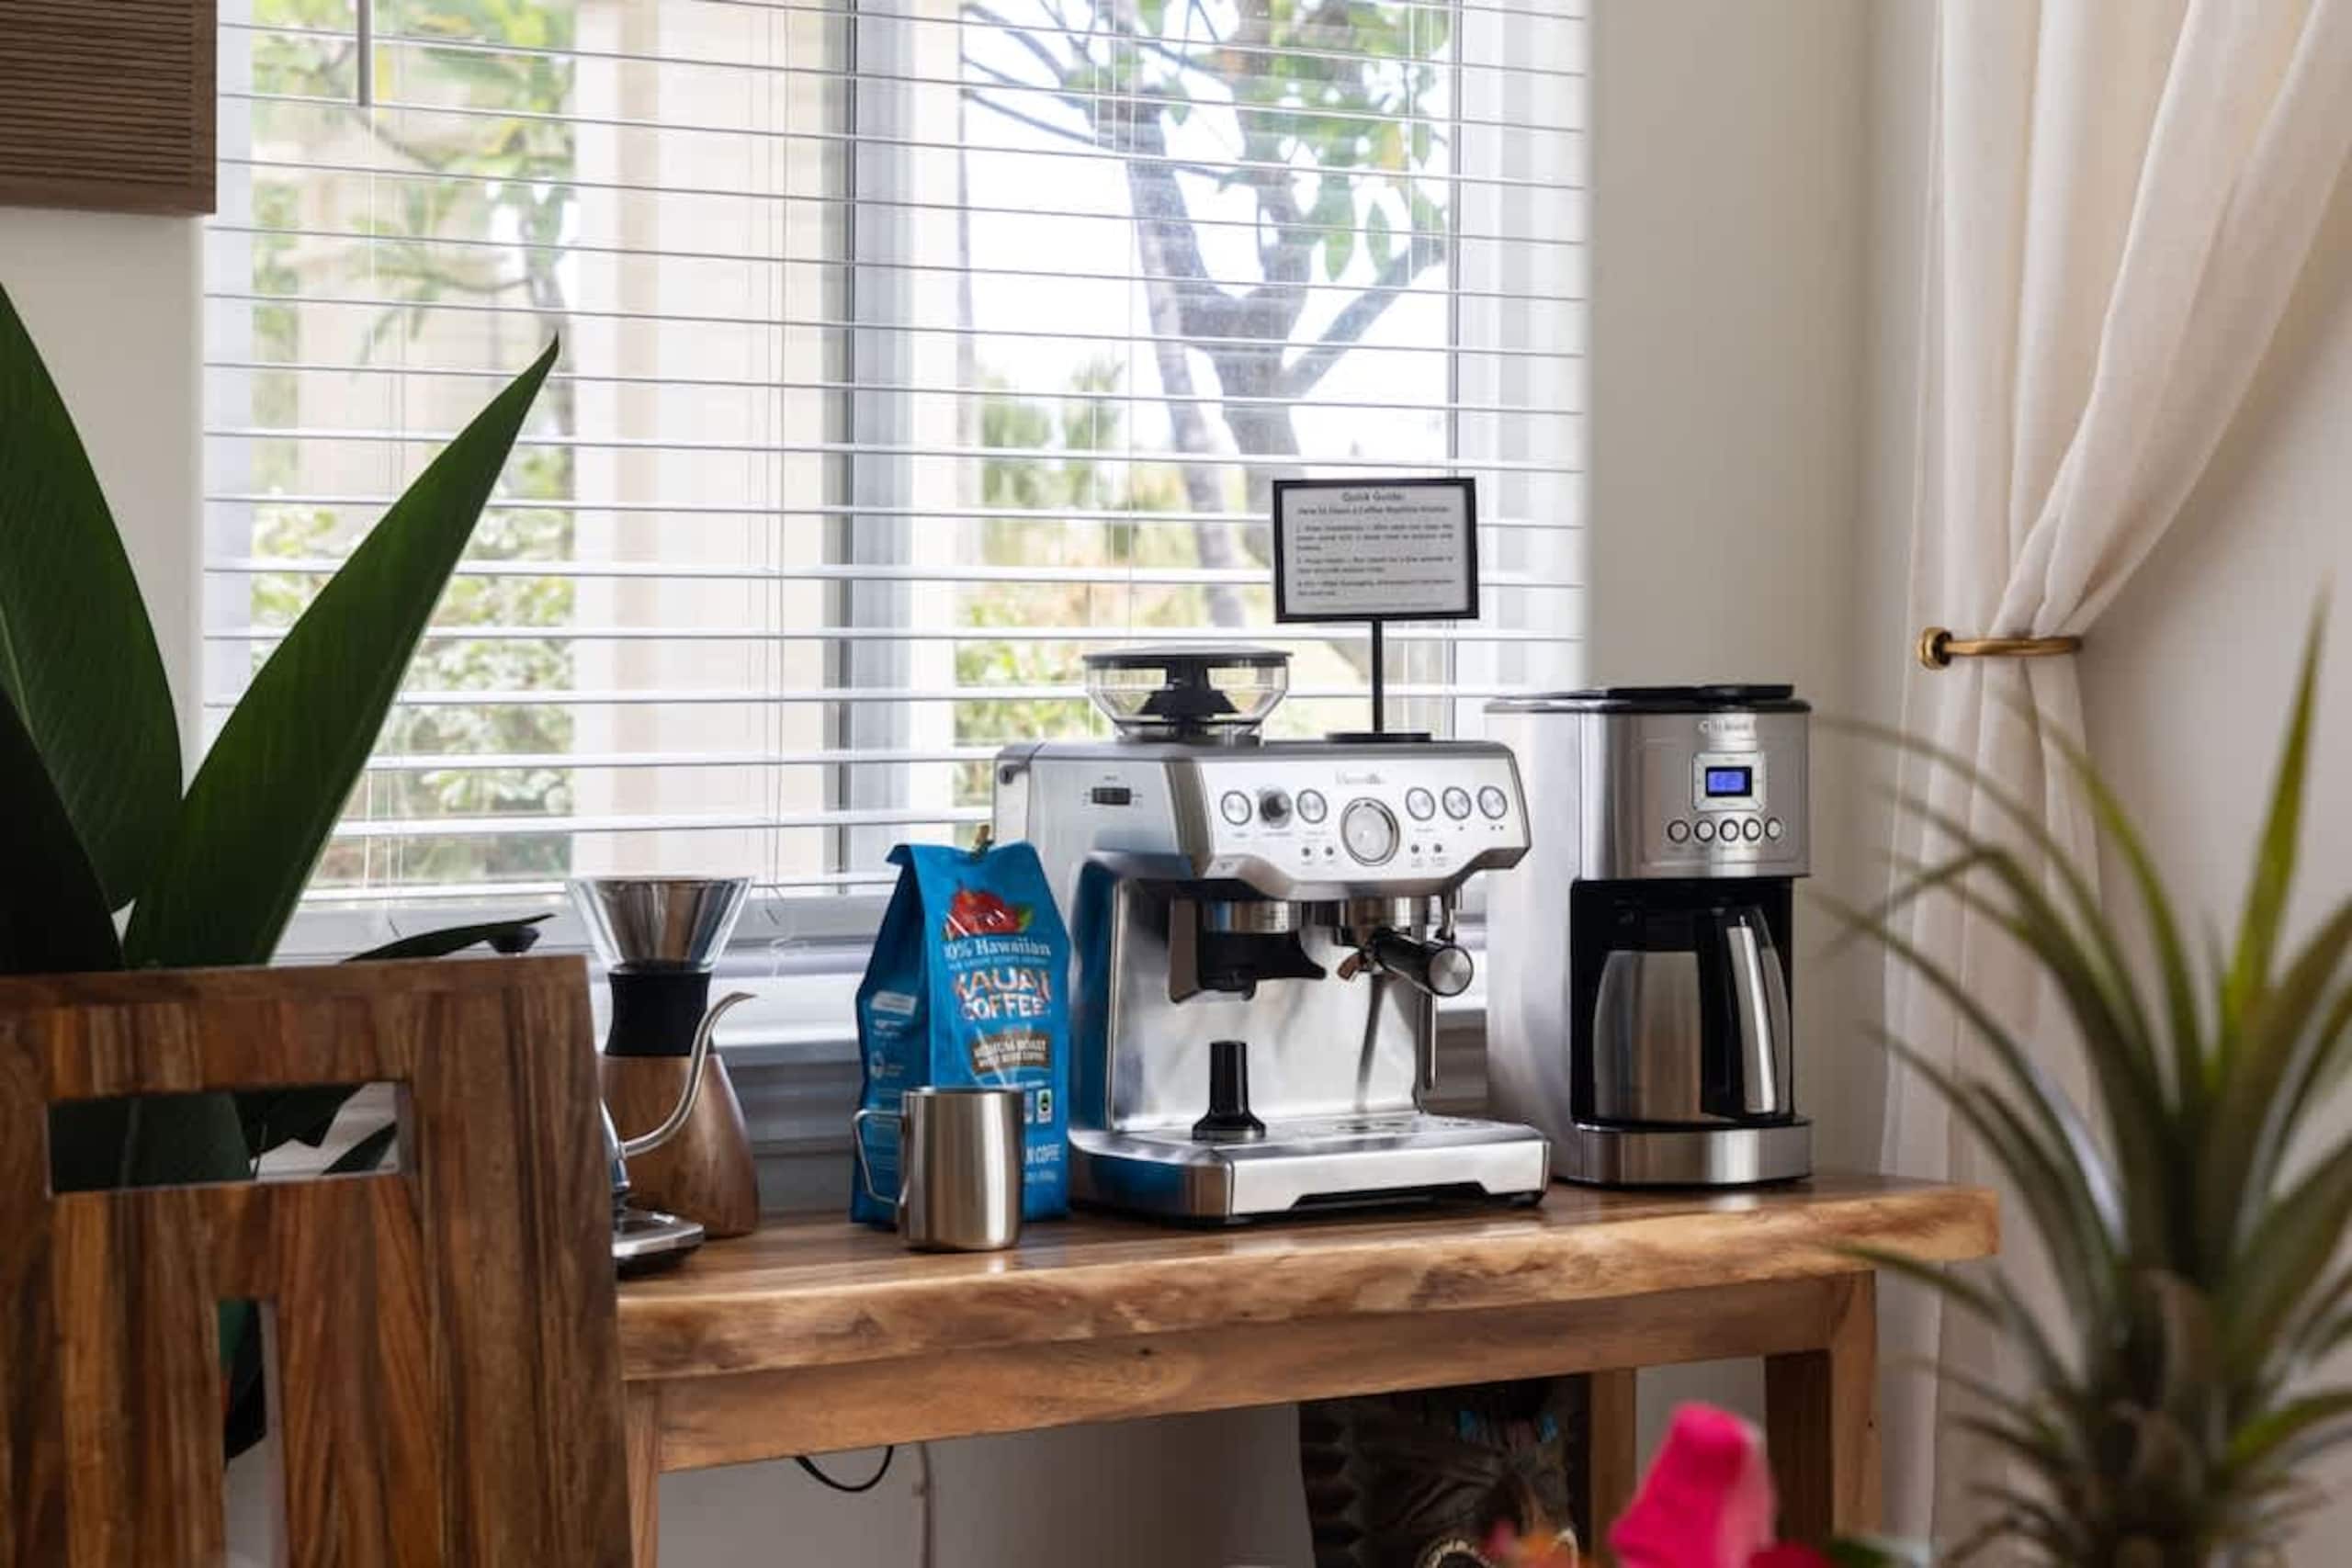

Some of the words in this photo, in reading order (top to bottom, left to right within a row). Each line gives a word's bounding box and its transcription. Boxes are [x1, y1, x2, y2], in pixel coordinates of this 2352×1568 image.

[1341, 491, 1370, 502] Quick
[975, 937, 1052, 956] Hawaiian
[960, 992, 1047, 1021] COFFEE
